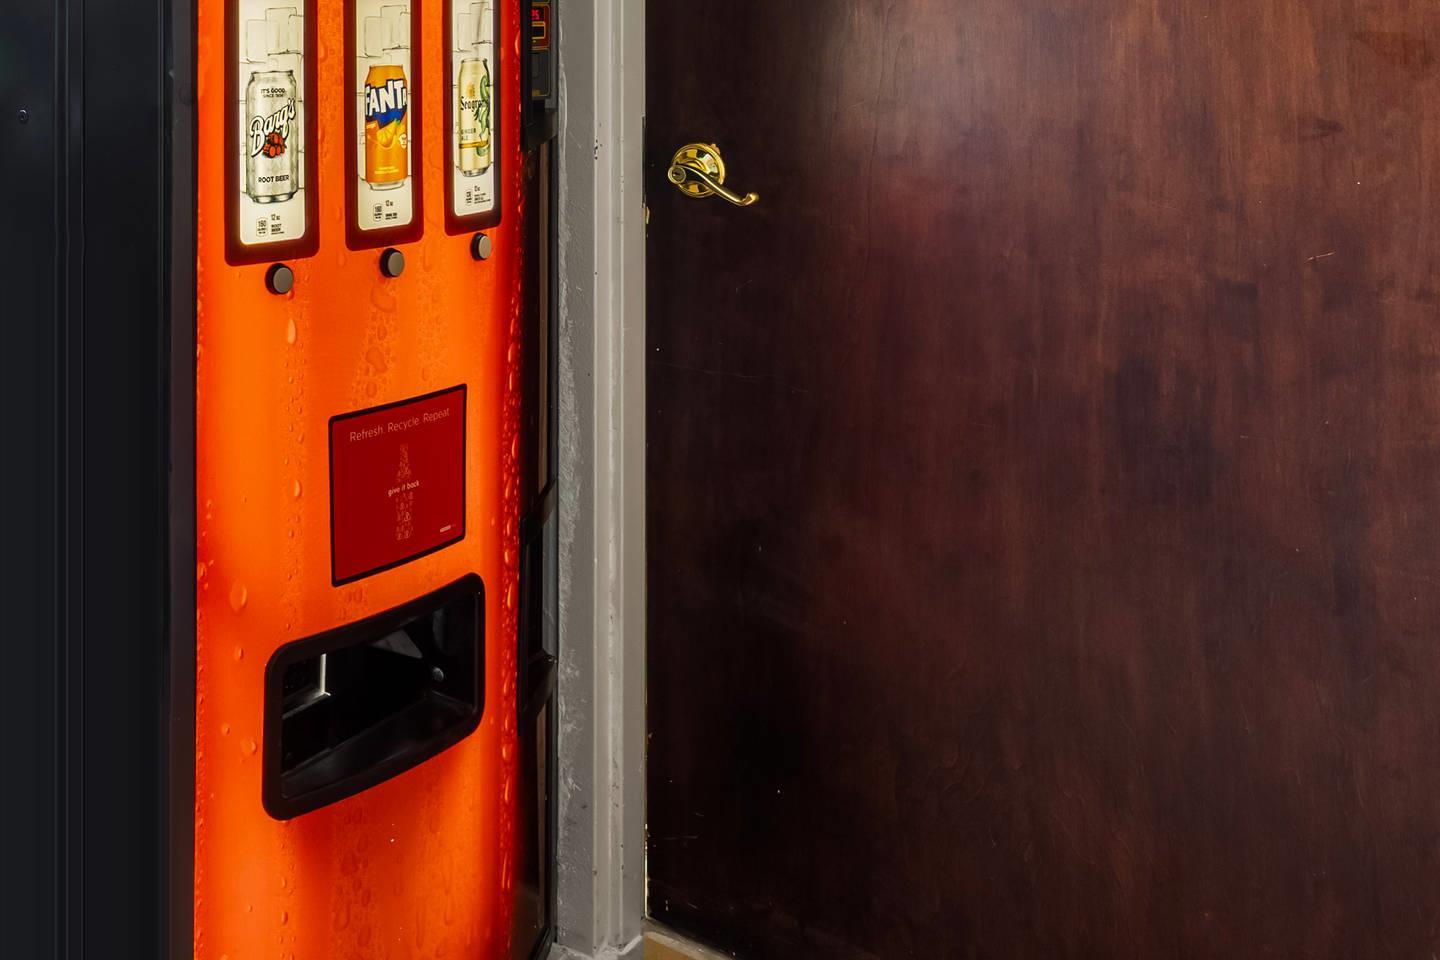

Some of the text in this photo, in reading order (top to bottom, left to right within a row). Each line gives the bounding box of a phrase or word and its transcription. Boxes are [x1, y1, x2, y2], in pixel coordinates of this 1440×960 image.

[460, 96, 487, 113] Seagra
[250, 98, 296, 158] Barq's
[275, 174, 290, 182] BEER
[423, 407, 450, 424] Repeat
[406, 480, 420, 490] back
